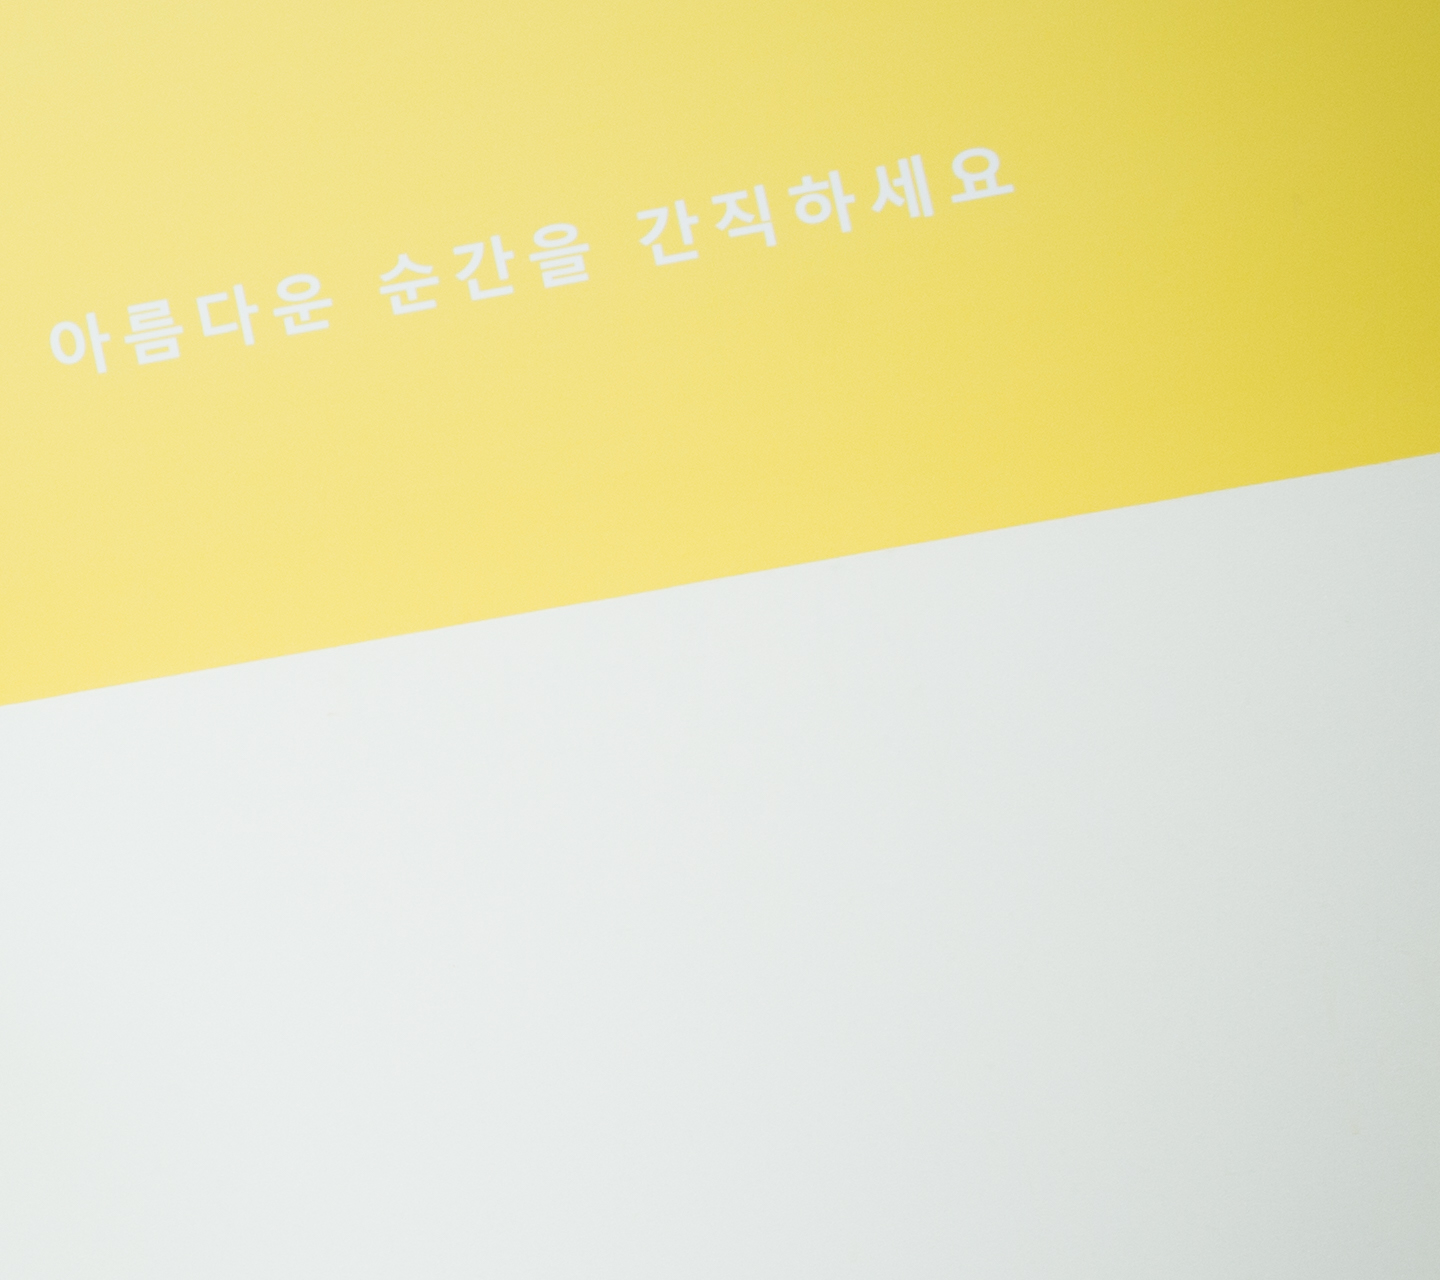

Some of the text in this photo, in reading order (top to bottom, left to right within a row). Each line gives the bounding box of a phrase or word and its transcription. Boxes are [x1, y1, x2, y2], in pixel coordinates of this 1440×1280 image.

[48, 146, 1016, 376] 아름다운 순간을 간직하세요
